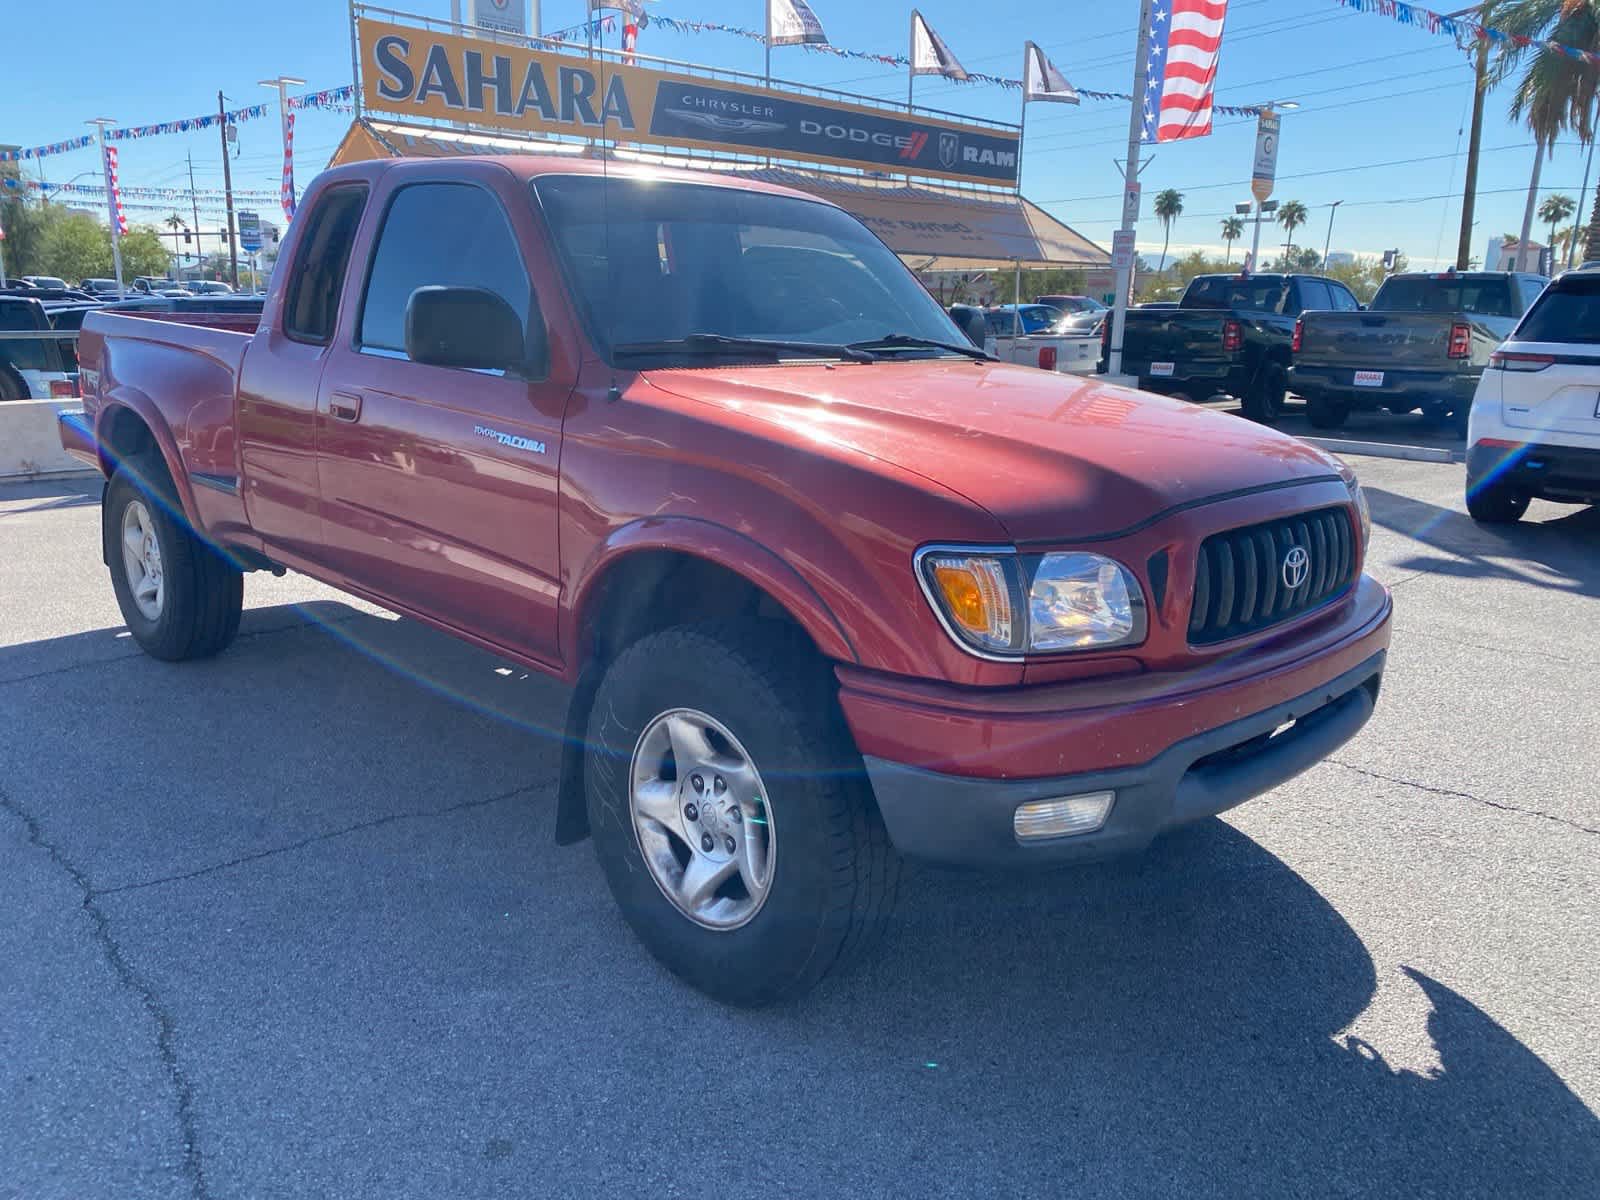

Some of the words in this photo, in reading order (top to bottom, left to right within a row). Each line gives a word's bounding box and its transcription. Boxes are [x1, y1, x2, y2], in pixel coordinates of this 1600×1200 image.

[374, 35, 635, 131] SAHARA
[682, 95, 775, 117] CHRYSLER
[800, 119, 914, 149] DODGE
[963, 145, 1016, 168] RAM
[497, 432, 545, 454] TACOMA
